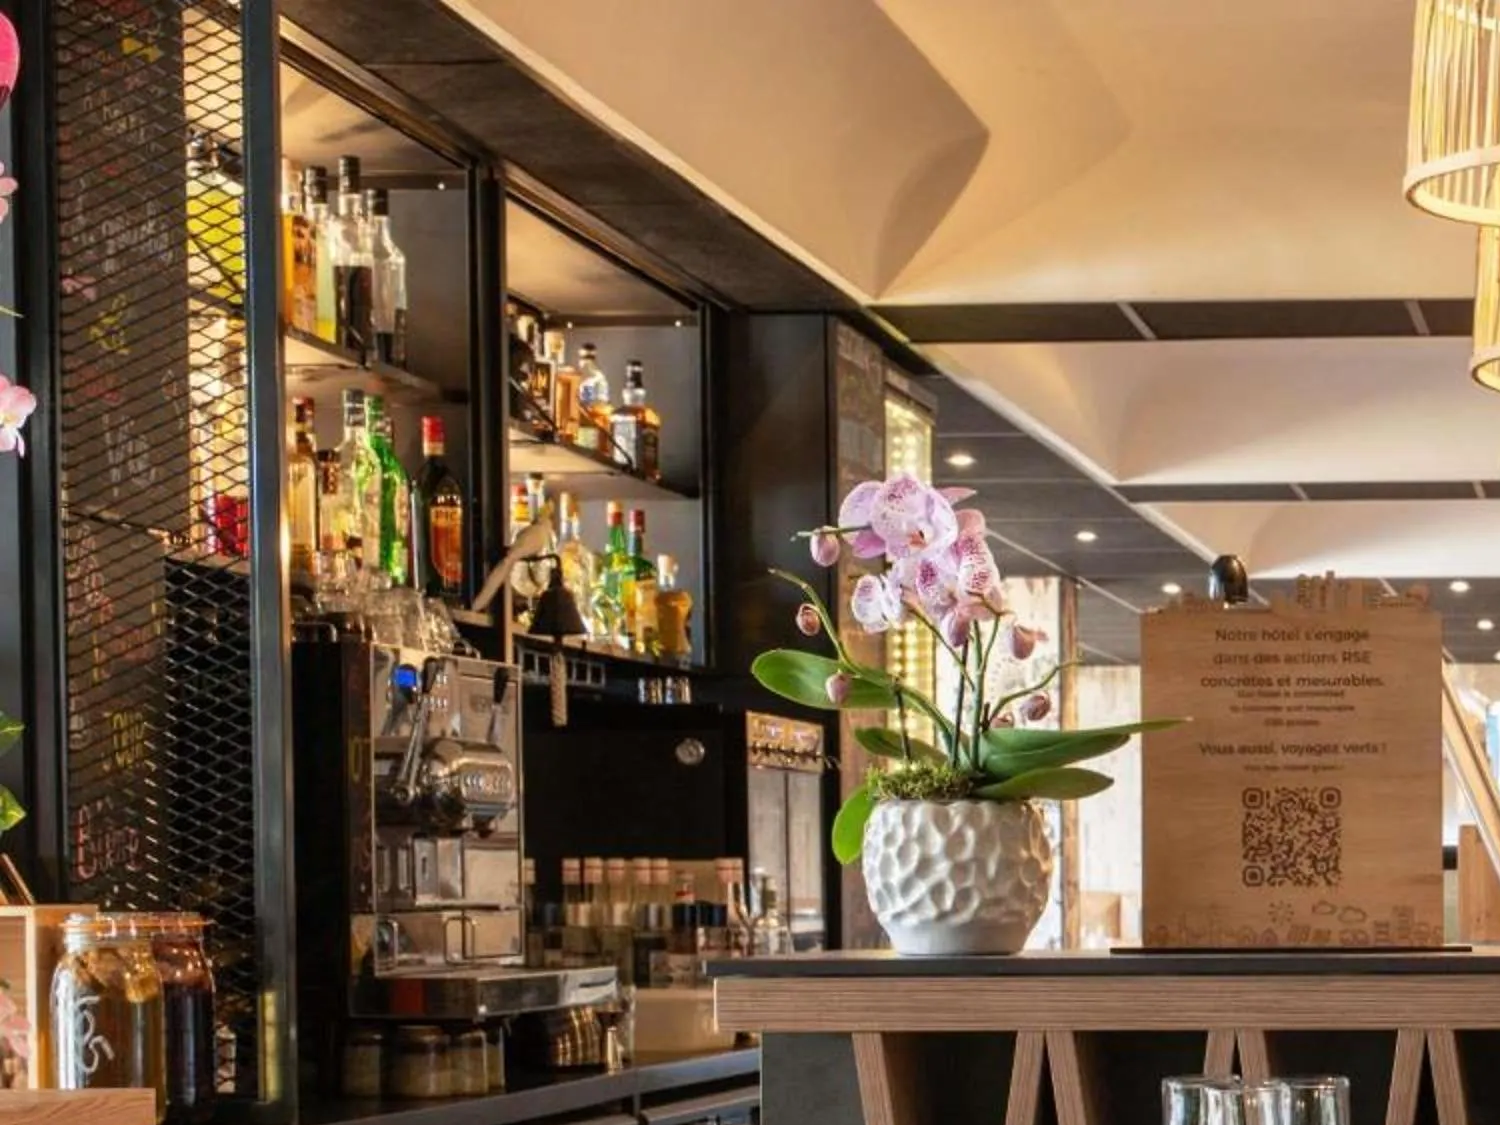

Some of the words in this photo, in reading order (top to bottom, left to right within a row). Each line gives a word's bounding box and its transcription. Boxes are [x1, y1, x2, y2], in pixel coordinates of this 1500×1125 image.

[1215, 629, 1257, 641] Notre
[1262, 628, 1300, 641] hôtel
[1214, 652, 1249, 665] dans
[1253, 652, 1281, 665] des
[1284, 652, 1338, 665] actions
[1342, 650, 1372, 665] RSE
[1277, 674, 1291, 688] et
[1200, 743, 1235, 755] Vous
[1281, 745, 1339, 757] voyagez
